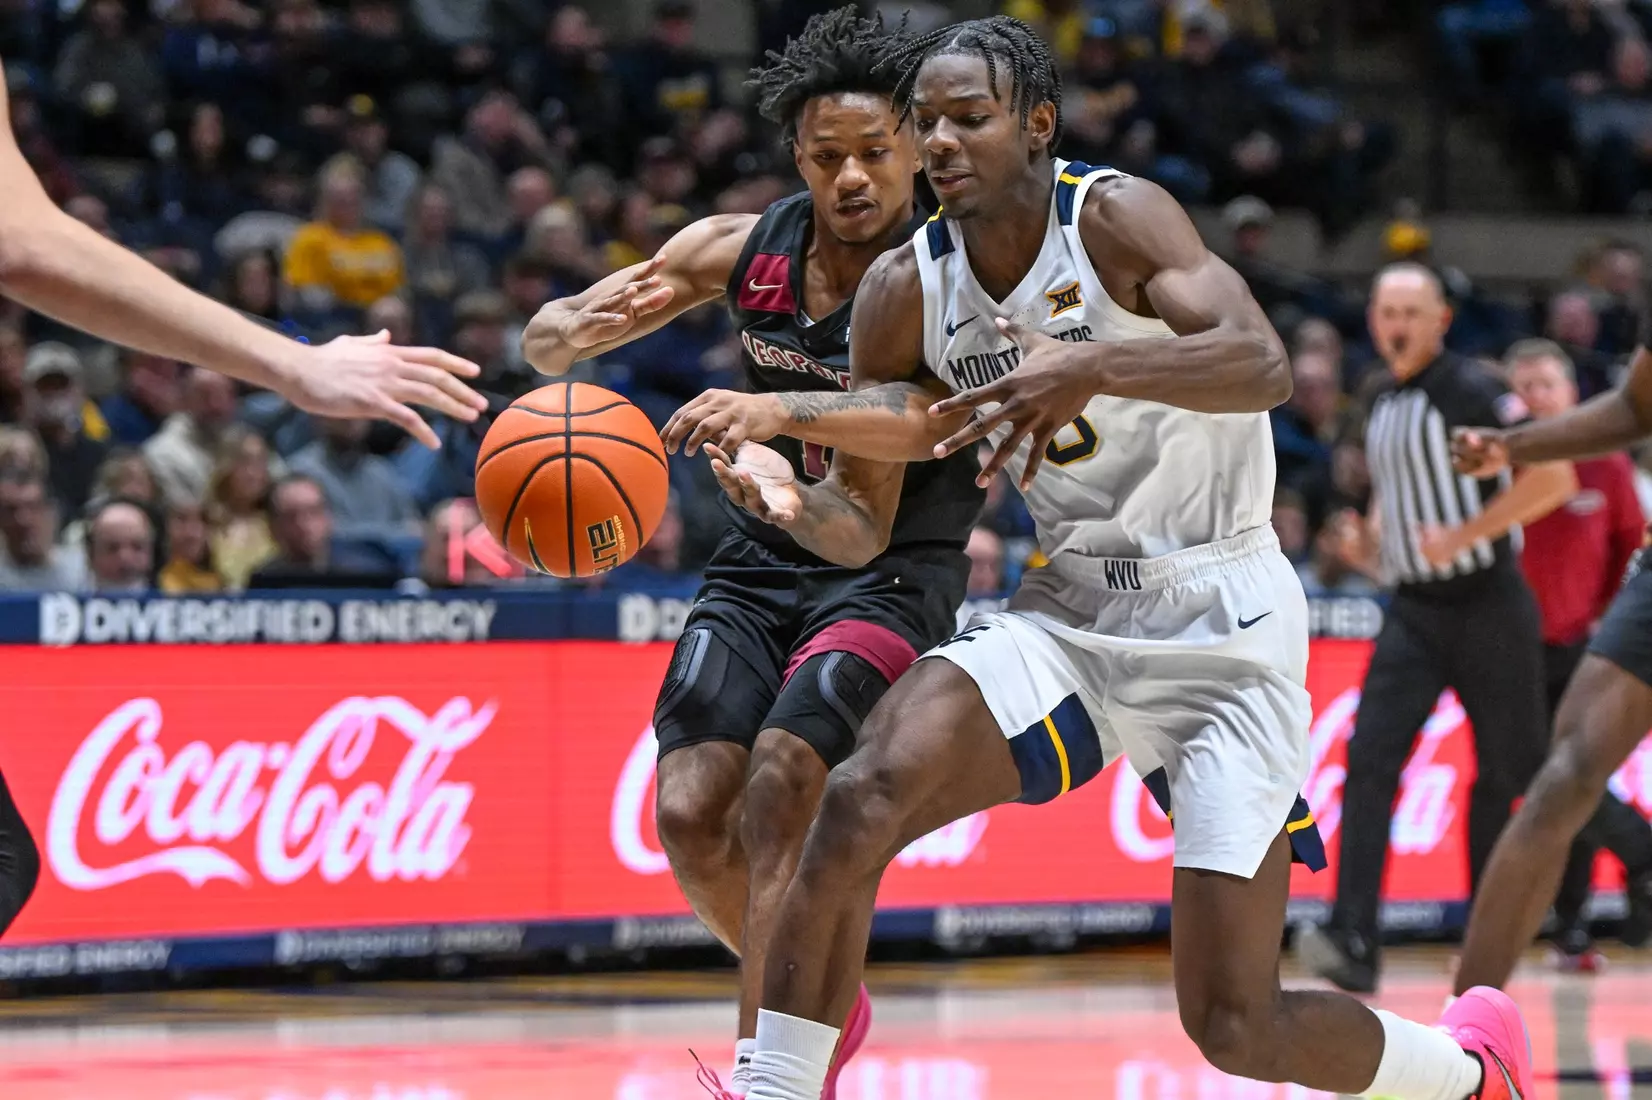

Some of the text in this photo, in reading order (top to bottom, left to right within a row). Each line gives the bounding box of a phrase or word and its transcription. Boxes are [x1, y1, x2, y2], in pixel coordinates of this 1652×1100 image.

[1104, 559, 1142, 590] WVU
[84, 598, 335, 643] DIVERSIFIED
[339, 598, 497, 643] ENERGY
